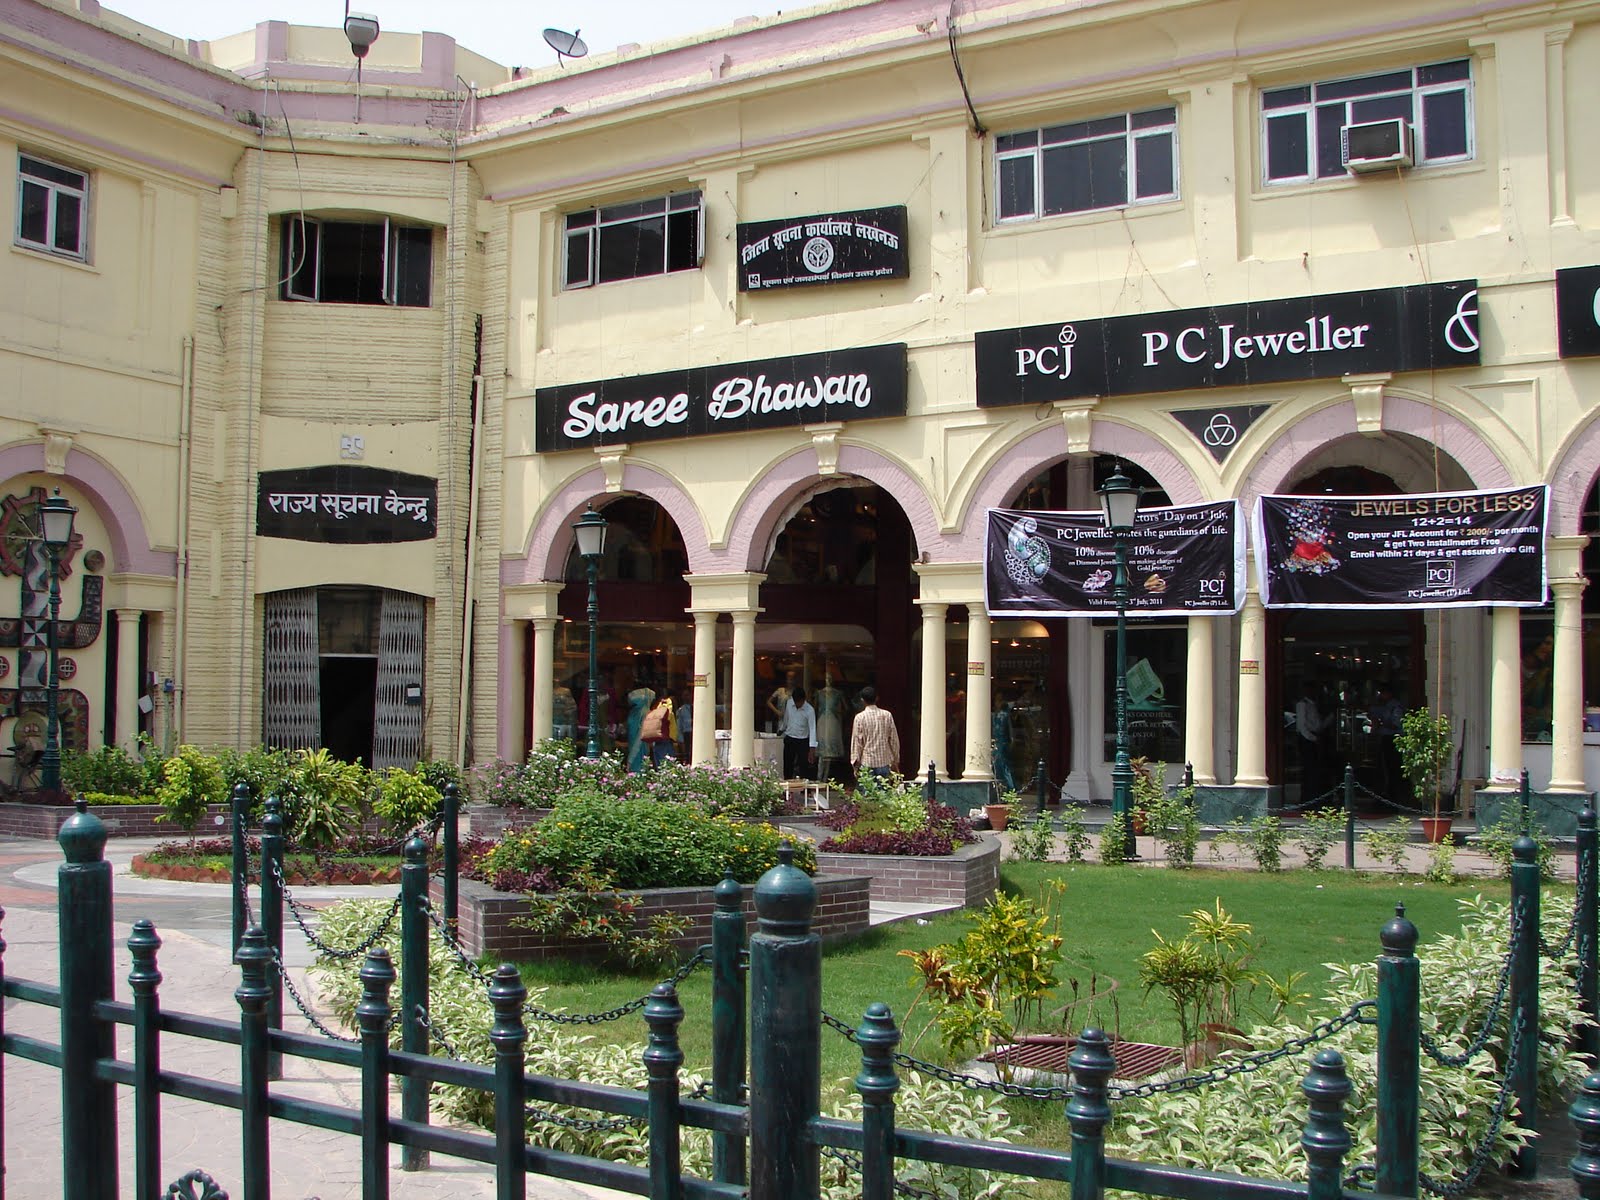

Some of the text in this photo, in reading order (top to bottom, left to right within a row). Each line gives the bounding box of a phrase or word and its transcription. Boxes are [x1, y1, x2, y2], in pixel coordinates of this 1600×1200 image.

[742, 236, 770, 264] जिला
[772, 225, 803, 250] सूचना
[804, 218, 852, 236] कार्यालय
[854, 223, 899, 249] लखनऊ
[1016, 341, 1074, 379] PCJ
[1214, 315, 1370, 369] Jeweller
[563, 374, 871, 439] Saree Bhawan
[269, 490, 429, 522] राज्य सूचना केन्द्र
[1351, 495, 1535, 516] JEWELS FOR LESS
[1164, 511, 1185, 522] Day
[1412, 516, 1472, 526] 12+2=14
[1057, 529, 1072, 539] PC
[1144, 528, 1157, 537] the
[1158, 528, 1198, 538] guardians
[1199, 526, 1209, 535] of
[1212, 526, 1228, 534] life.
[1347, 532, 1369, 540] Open
[1133, 546, 1154, 555] 10%
[1392, 541, 1406, 549] get
[1415, 549, 1435, 558] days
[1446, 549, 1460, 557] get
[1462, 547, 1496, 555] assured
[1519, 545, 1535, 553] Gift
[1075, 547, 1094, 557] 10%
[1428, 569, 1452, 582] PCJ
[1199, 579, 1225, 594] PCJ
